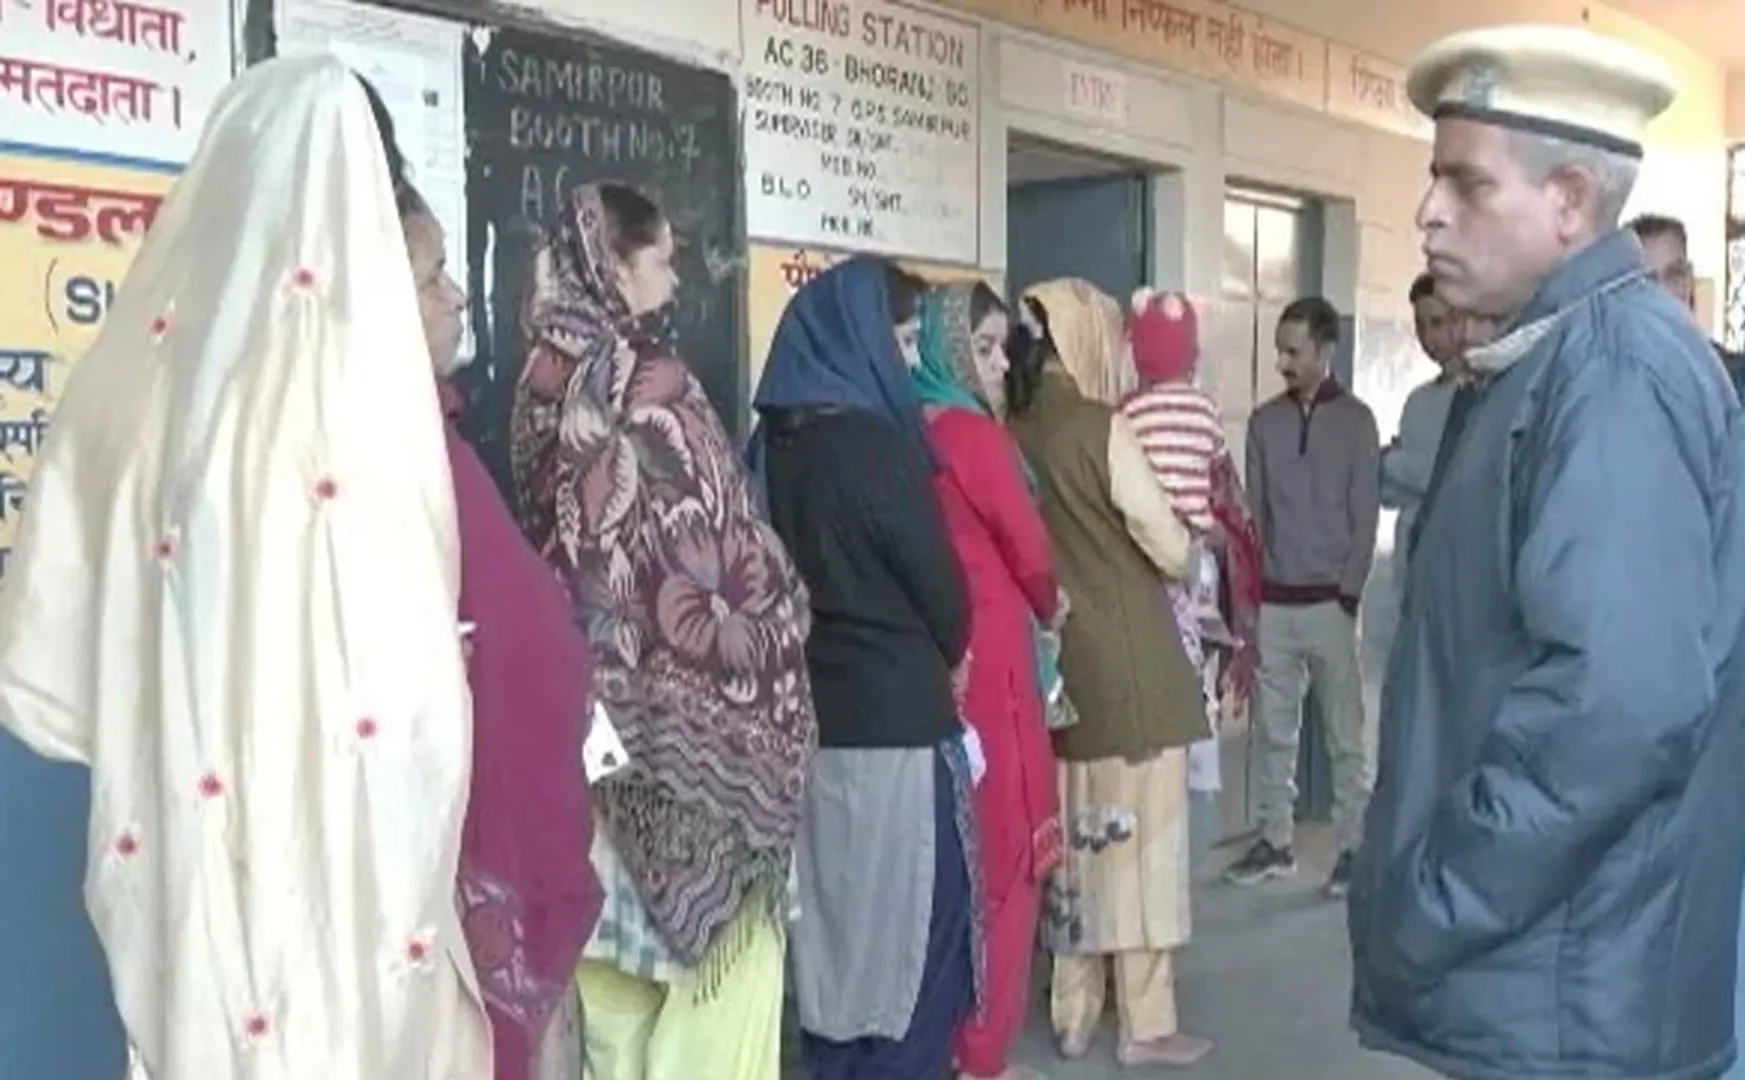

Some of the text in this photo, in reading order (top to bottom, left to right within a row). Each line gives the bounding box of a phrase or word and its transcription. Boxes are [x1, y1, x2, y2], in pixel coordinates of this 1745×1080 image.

[764, 36, 793, 68] AC
[801, 43, 829, 74] 36
[862, 11, 964, 68] STATION
